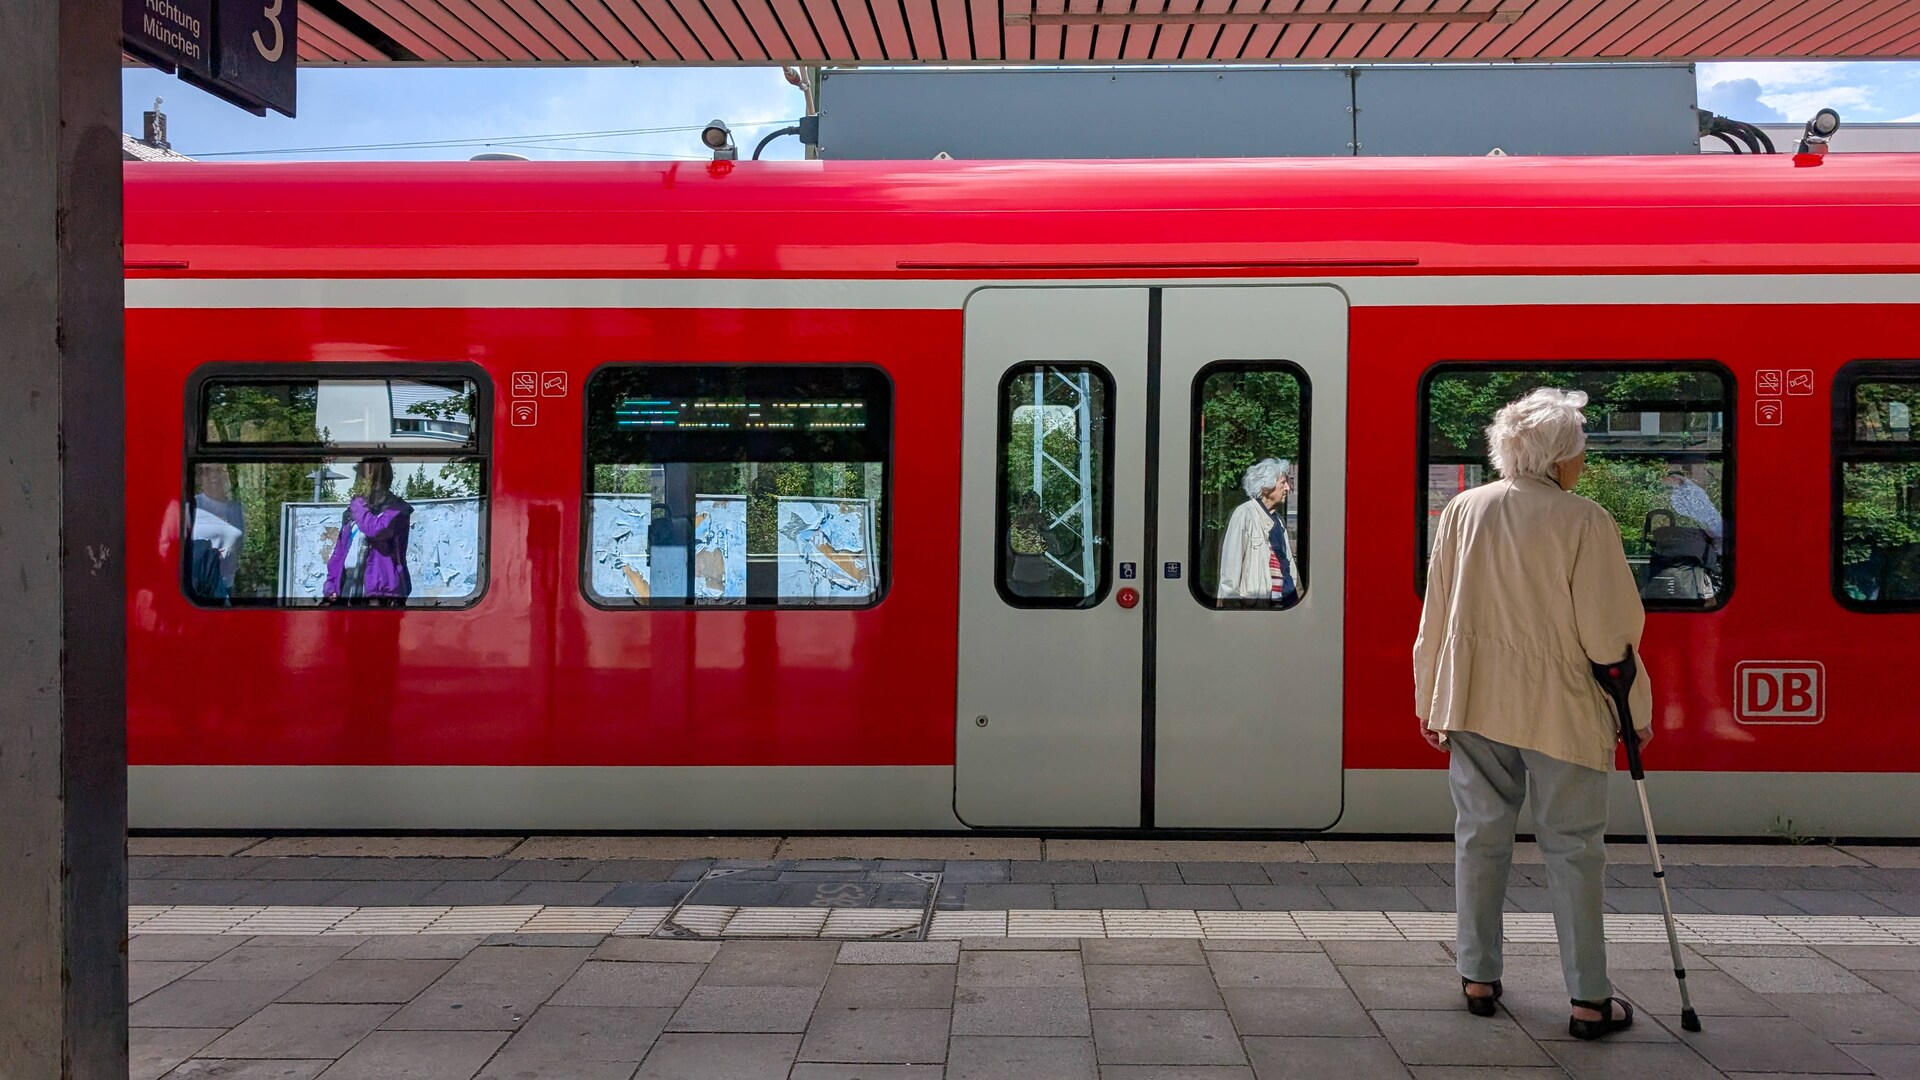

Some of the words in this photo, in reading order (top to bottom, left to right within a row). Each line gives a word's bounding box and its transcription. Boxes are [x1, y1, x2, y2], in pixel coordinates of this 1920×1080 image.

[143, 13, 200, 60] München
[252, 0, 284, 62] 3
[1748, 672, 1812, 712] DB
